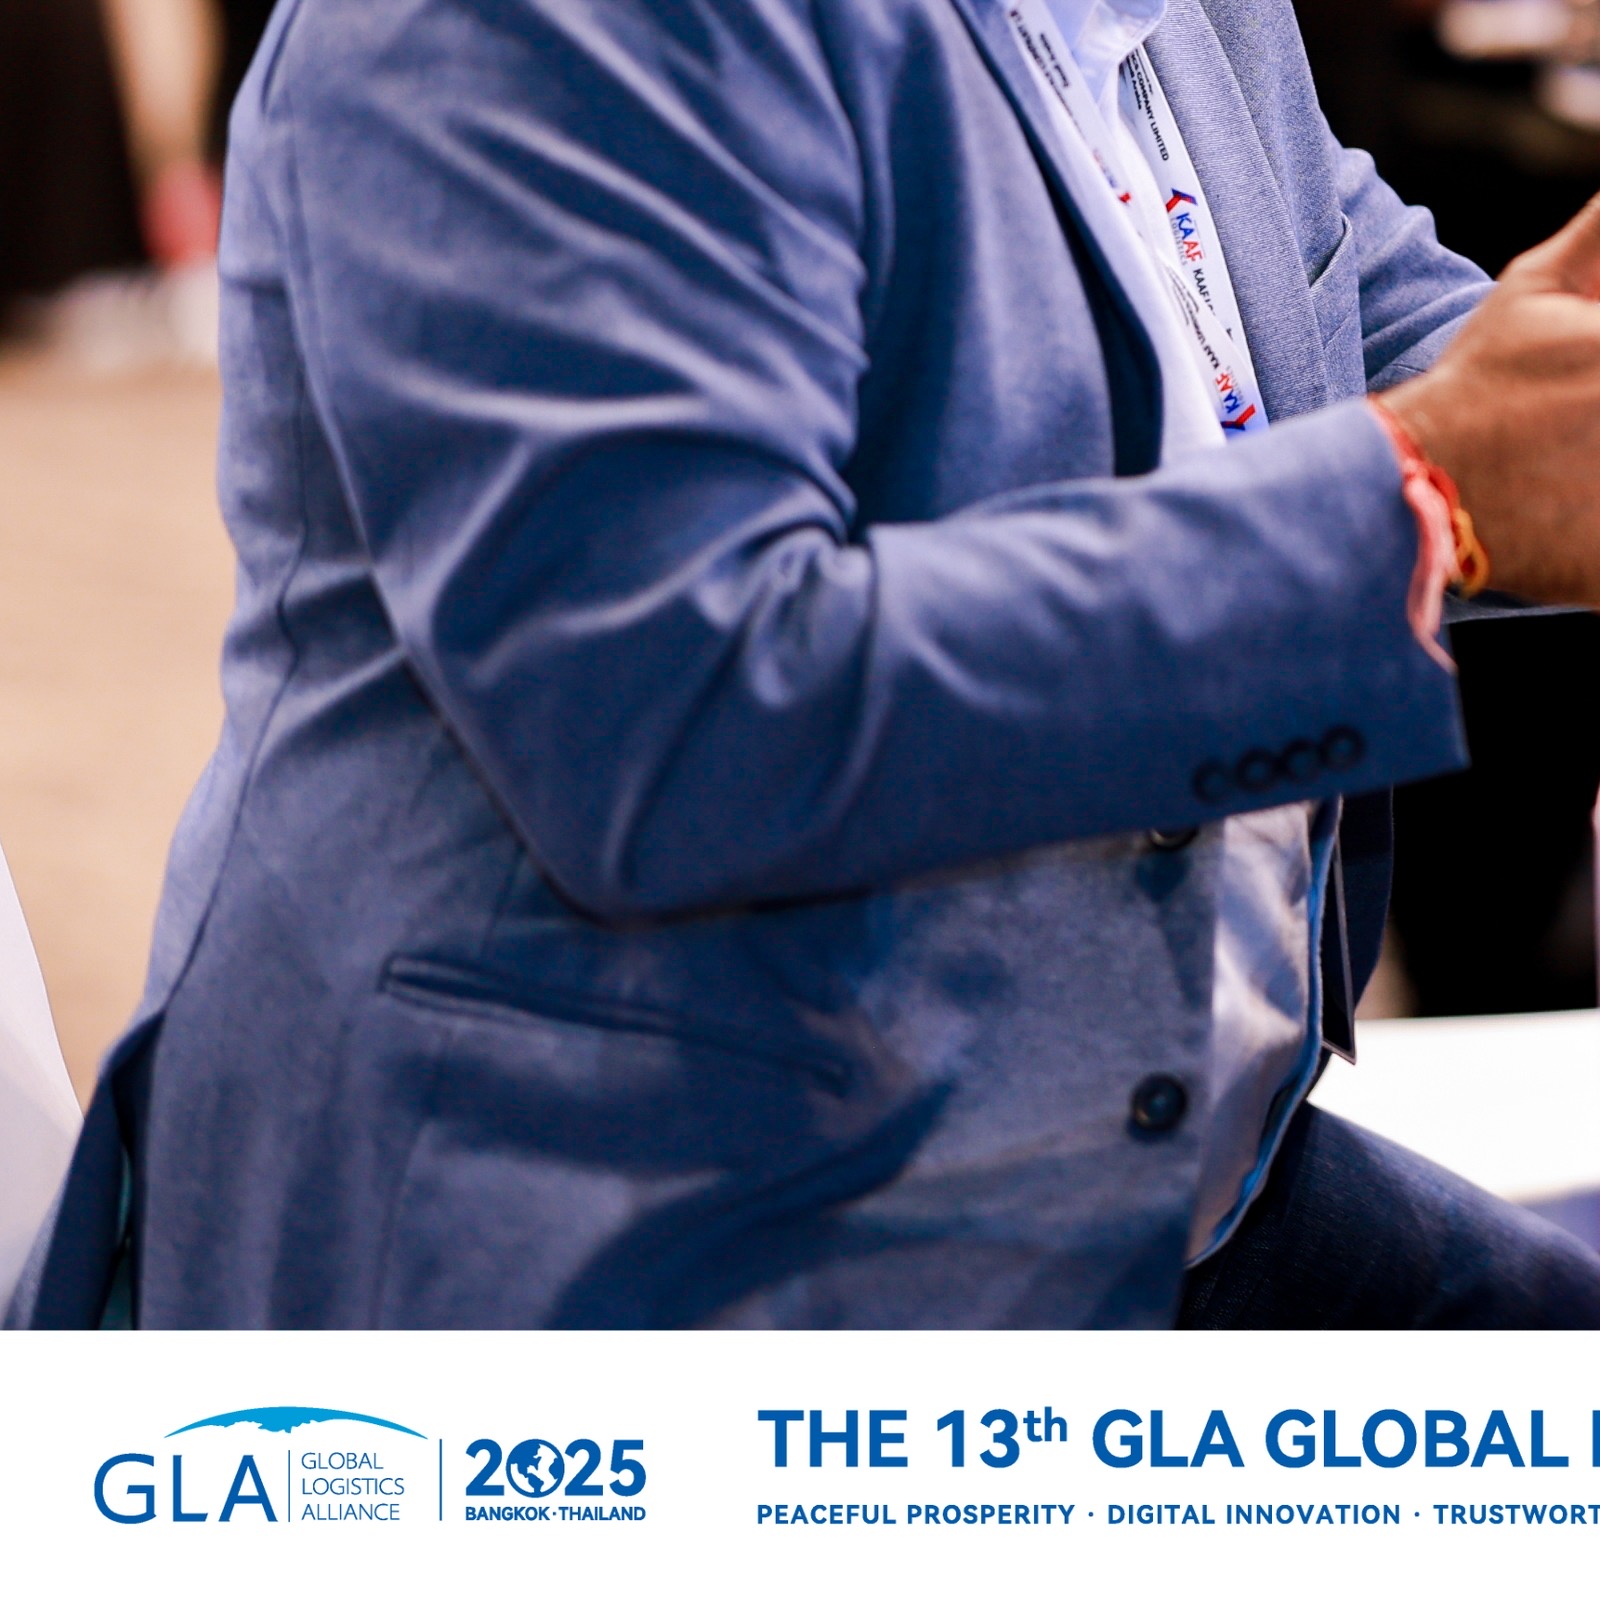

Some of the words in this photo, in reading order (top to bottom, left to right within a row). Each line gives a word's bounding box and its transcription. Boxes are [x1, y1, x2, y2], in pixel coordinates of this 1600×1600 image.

[1137, 71, 1154, 120] COMPANY
[1150, 122, 1169, 161] LIMITED
[1176, 212, 1204, 262] KAAF
[1193, 268, 1210, 299] KAAF
[1215, 372, 1240, 414] KAAF
